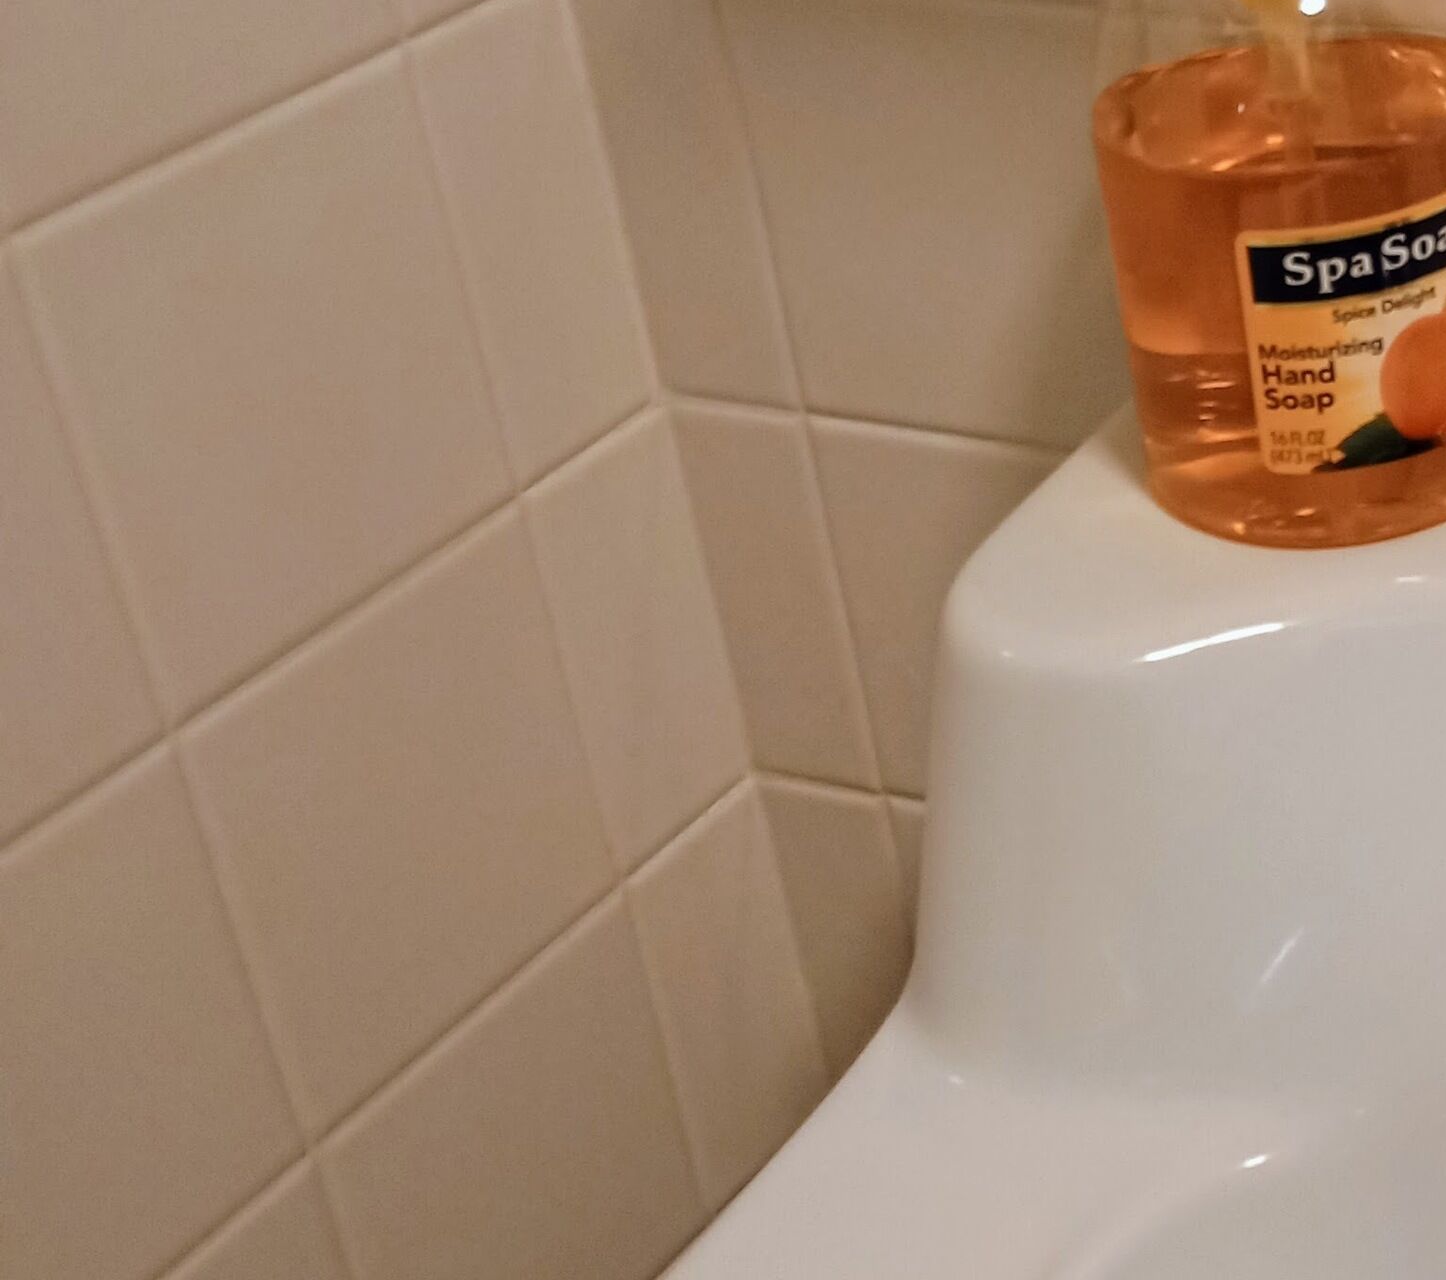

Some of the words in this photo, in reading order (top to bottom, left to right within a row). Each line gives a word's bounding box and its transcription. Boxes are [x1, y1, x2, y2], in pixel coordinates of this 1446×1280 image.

[1281, 251, 1374, 294] Spa
[1333, 304, 1376, 325] Spice
[1381, 287, 1435, 314] Delight
[1258, 337, 1383, 362] Moisturizing
[1261, 361, 1336, 385] Hand
[1264, 388, 1335, 413] Soap
